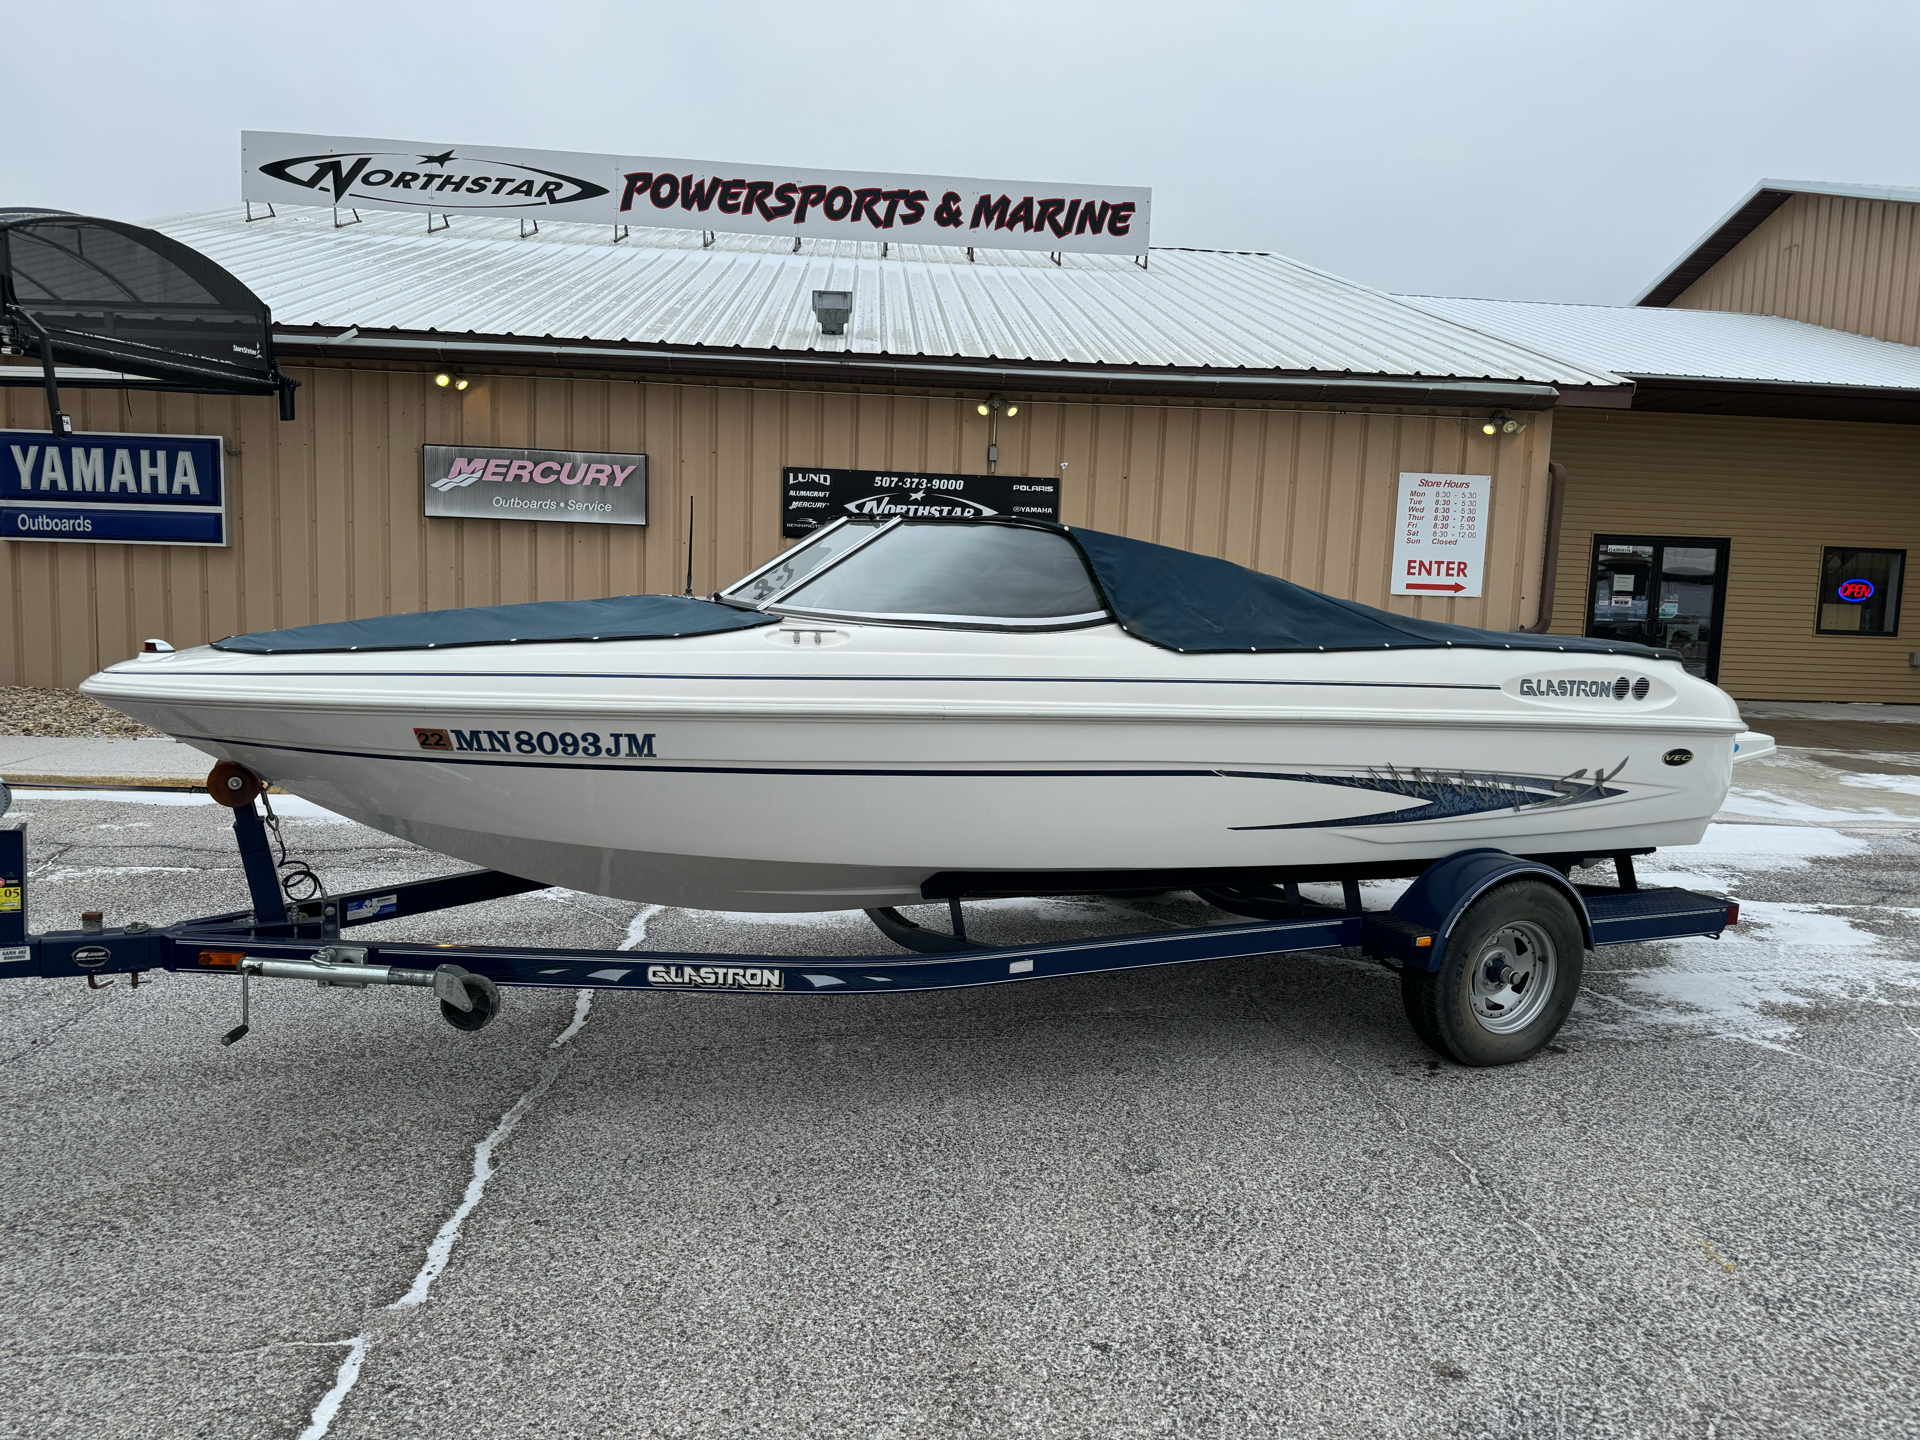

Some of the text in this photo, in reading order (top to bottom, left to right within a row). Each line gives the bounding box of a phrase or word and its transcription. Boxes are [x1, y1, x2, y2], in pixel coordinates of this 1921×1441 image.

[305, 157, 564, 204] NORTHSTAR
[620, 172, 1136, 239] POWERSPORTS & MARINE
[10, 445, 200, 494] YAMAHA
[447, 457, 637, 487] MERCURY
[788, 473, 830, 485] LUND
[874, 476, 964, 490] 507-373-9000
[1418, 479, 1470, 488] Store Hours
[1013, 484, 1054, 492] POLARIS
[492, 496, 612, 512] Outboards Service
[790, 501, 827, 509] MERCURY
[17, 514, 92, 532] Outboards
[1407, 560, 1468, 577] ENTER
[1841, 584, 1871, 597] OPEN
[1520, 679, 1611, 698] GLASTRON
[420, 732, 446, 746] 22
[1664, 754, 1692, 762] VEC
[4, 889, 20, 898] 05
[648, 966, 781, 986] GLASTRON
